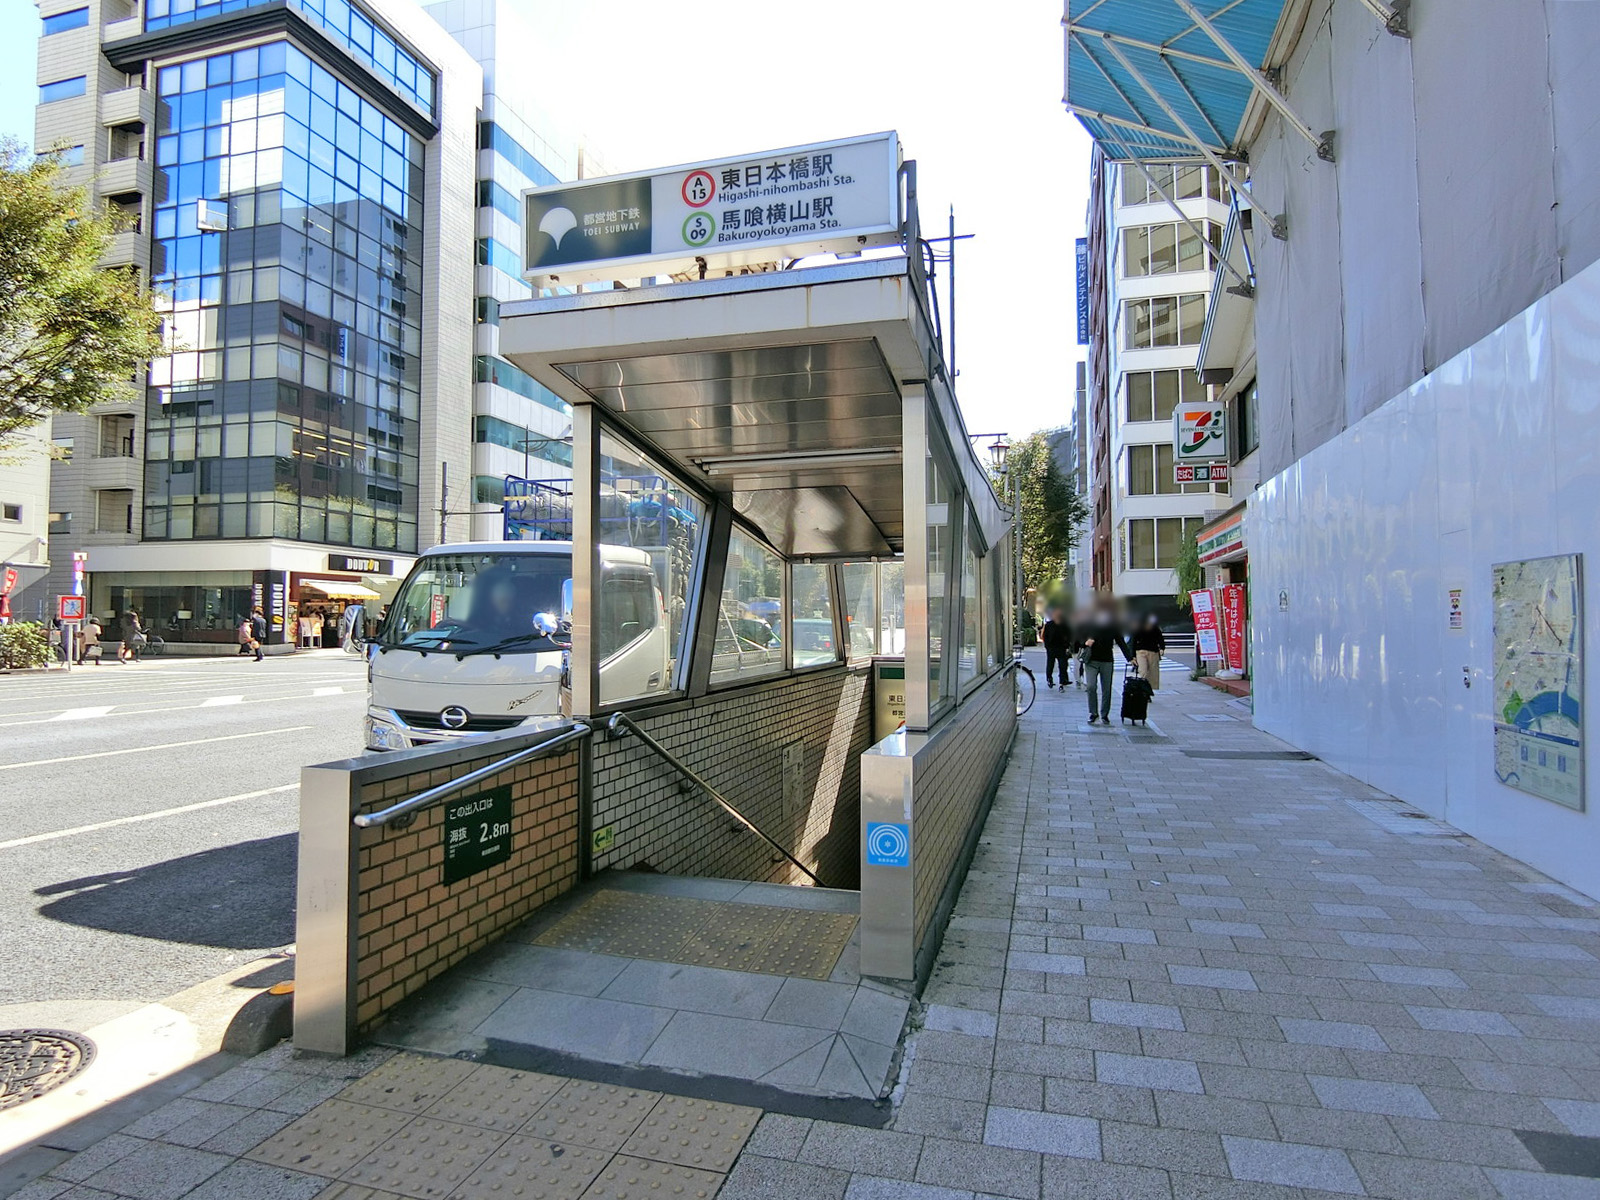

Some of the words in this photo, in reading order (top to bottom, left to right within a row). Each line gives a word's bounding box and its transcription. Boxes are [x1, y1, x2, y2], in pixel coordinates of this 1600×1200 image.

[721, 154, 833, 190] 東日本橋駅
[694, 177, 703, 187] A
[718, 177, 830, 203] Higashi-nihombashi
[833, 175, 855, 186] Sta.
[692, 188, 706, 200] 15
[583, 208, 640, 226] 都営地下鉄
[722, 196, 834, 231] 馬喰横山駅
[583, 227, 601, 237] TOEI
[605, 222, 640, 234] SUBWAY
[695, 218, 703, 228] S
[718, 222, 816, 242] Bakuroyokoyama
[820, 218, 841, 229] Sta.
[690, 229, 707, 240] 09
[1211, 466, 1227, 478] ATM
[1229, 588, 1239, 639] 年賀はがき
[888, 694, 905, 703] 東日
[449, 798, 493, 820] この出入口は
[449, 827, 467, 844] 海抜
[480, 822, 509, 843] 2.8m
